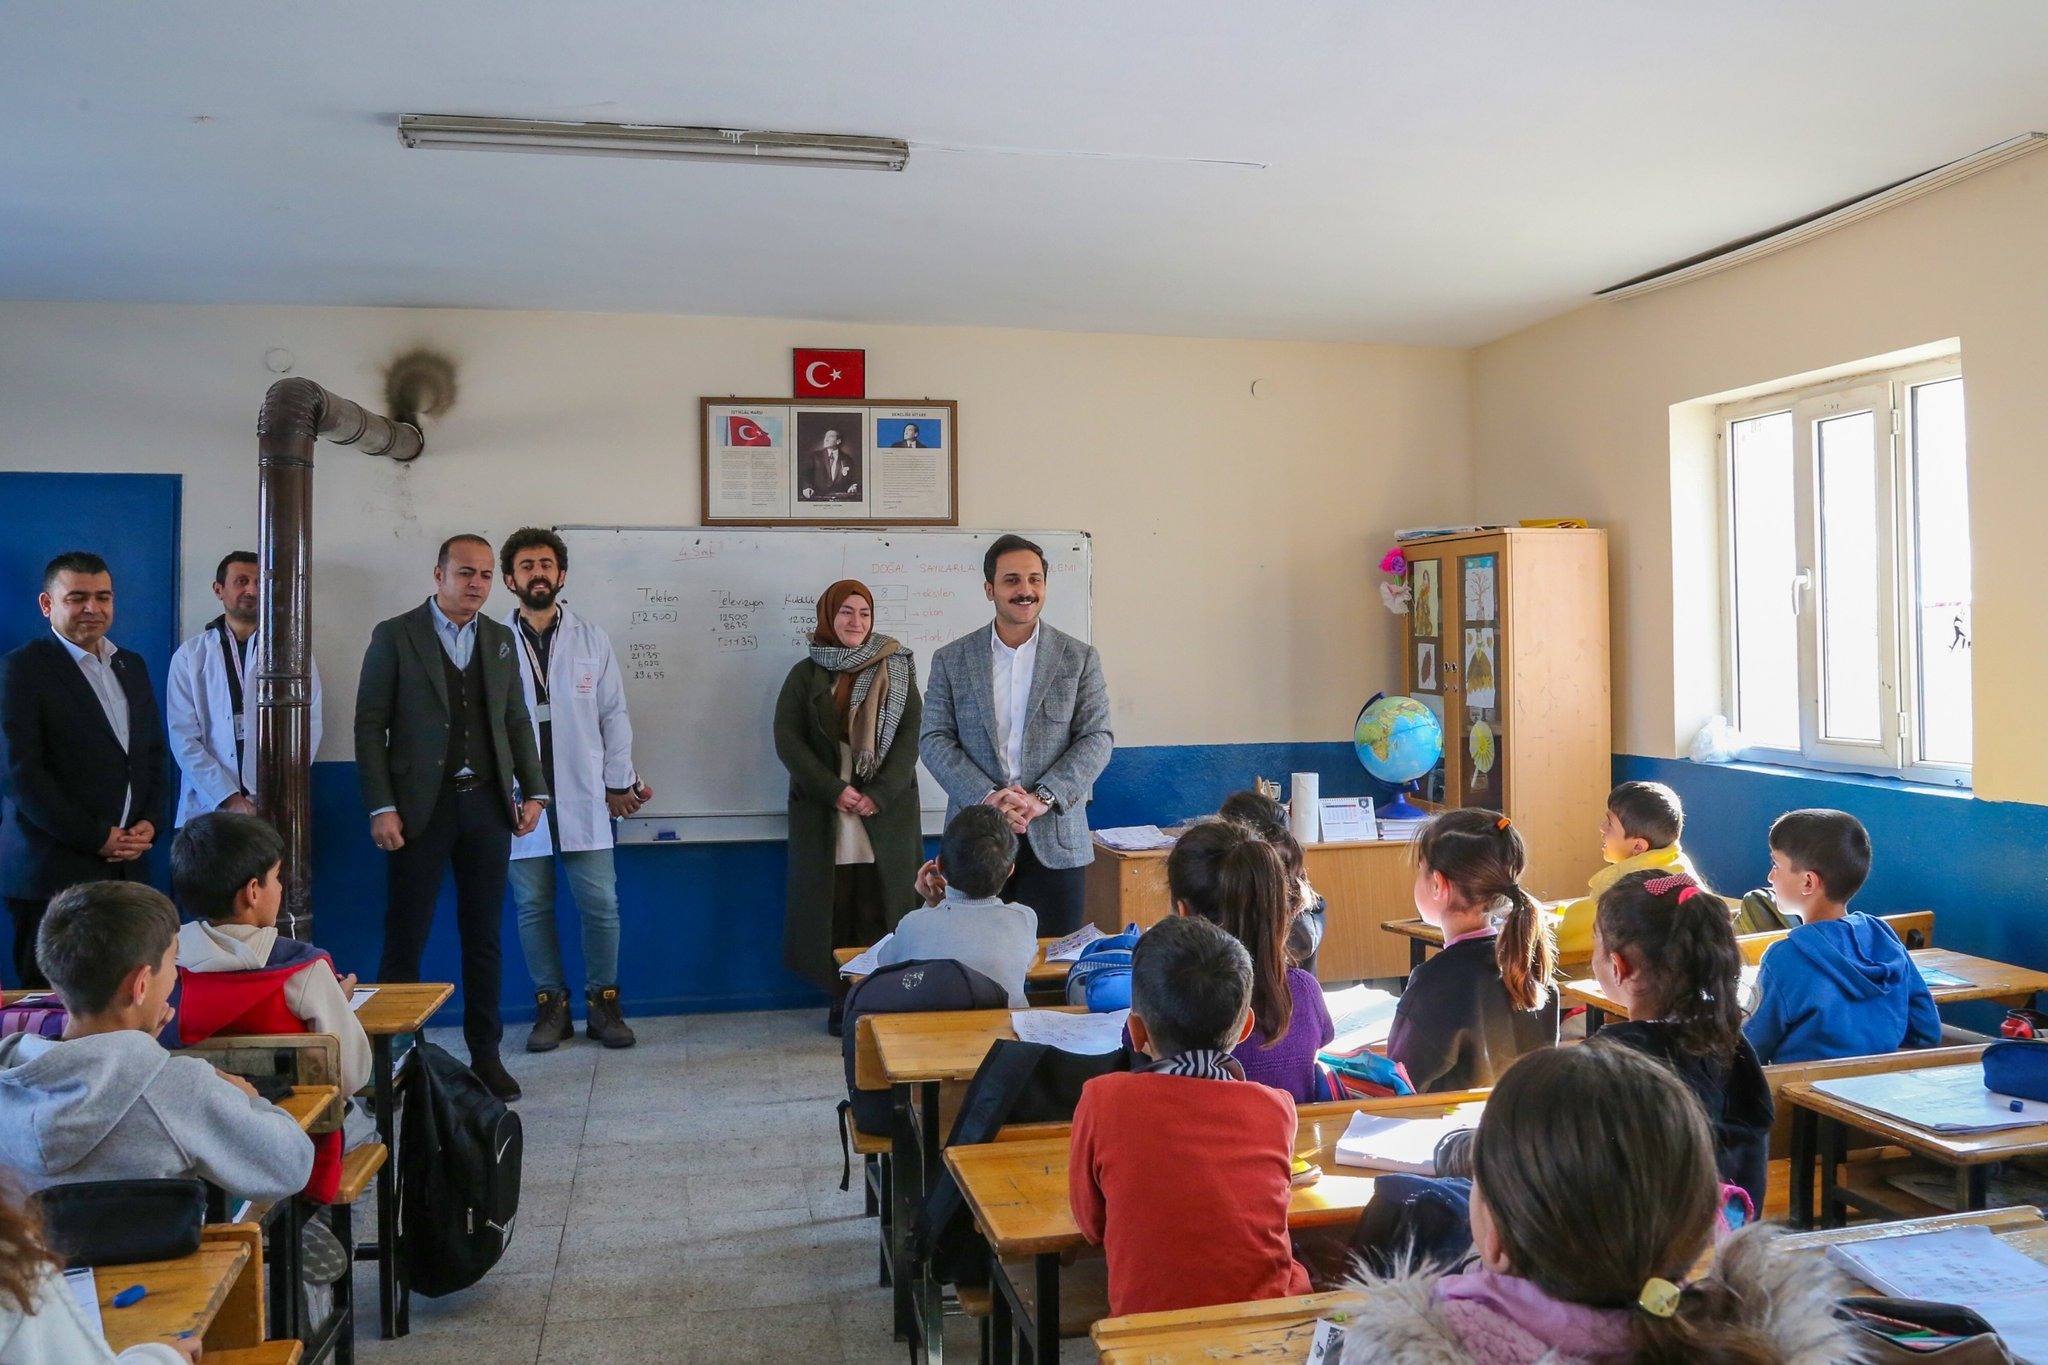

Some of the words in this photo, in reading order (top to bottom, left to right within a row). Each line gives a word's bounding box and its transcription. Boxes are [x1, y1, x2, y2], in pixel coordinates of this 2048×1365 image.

[871, 561, 909, 575] DOĞAL
[635, 586, 680, 604] Telefon
[711, 589, 764, 613] Televizyon
